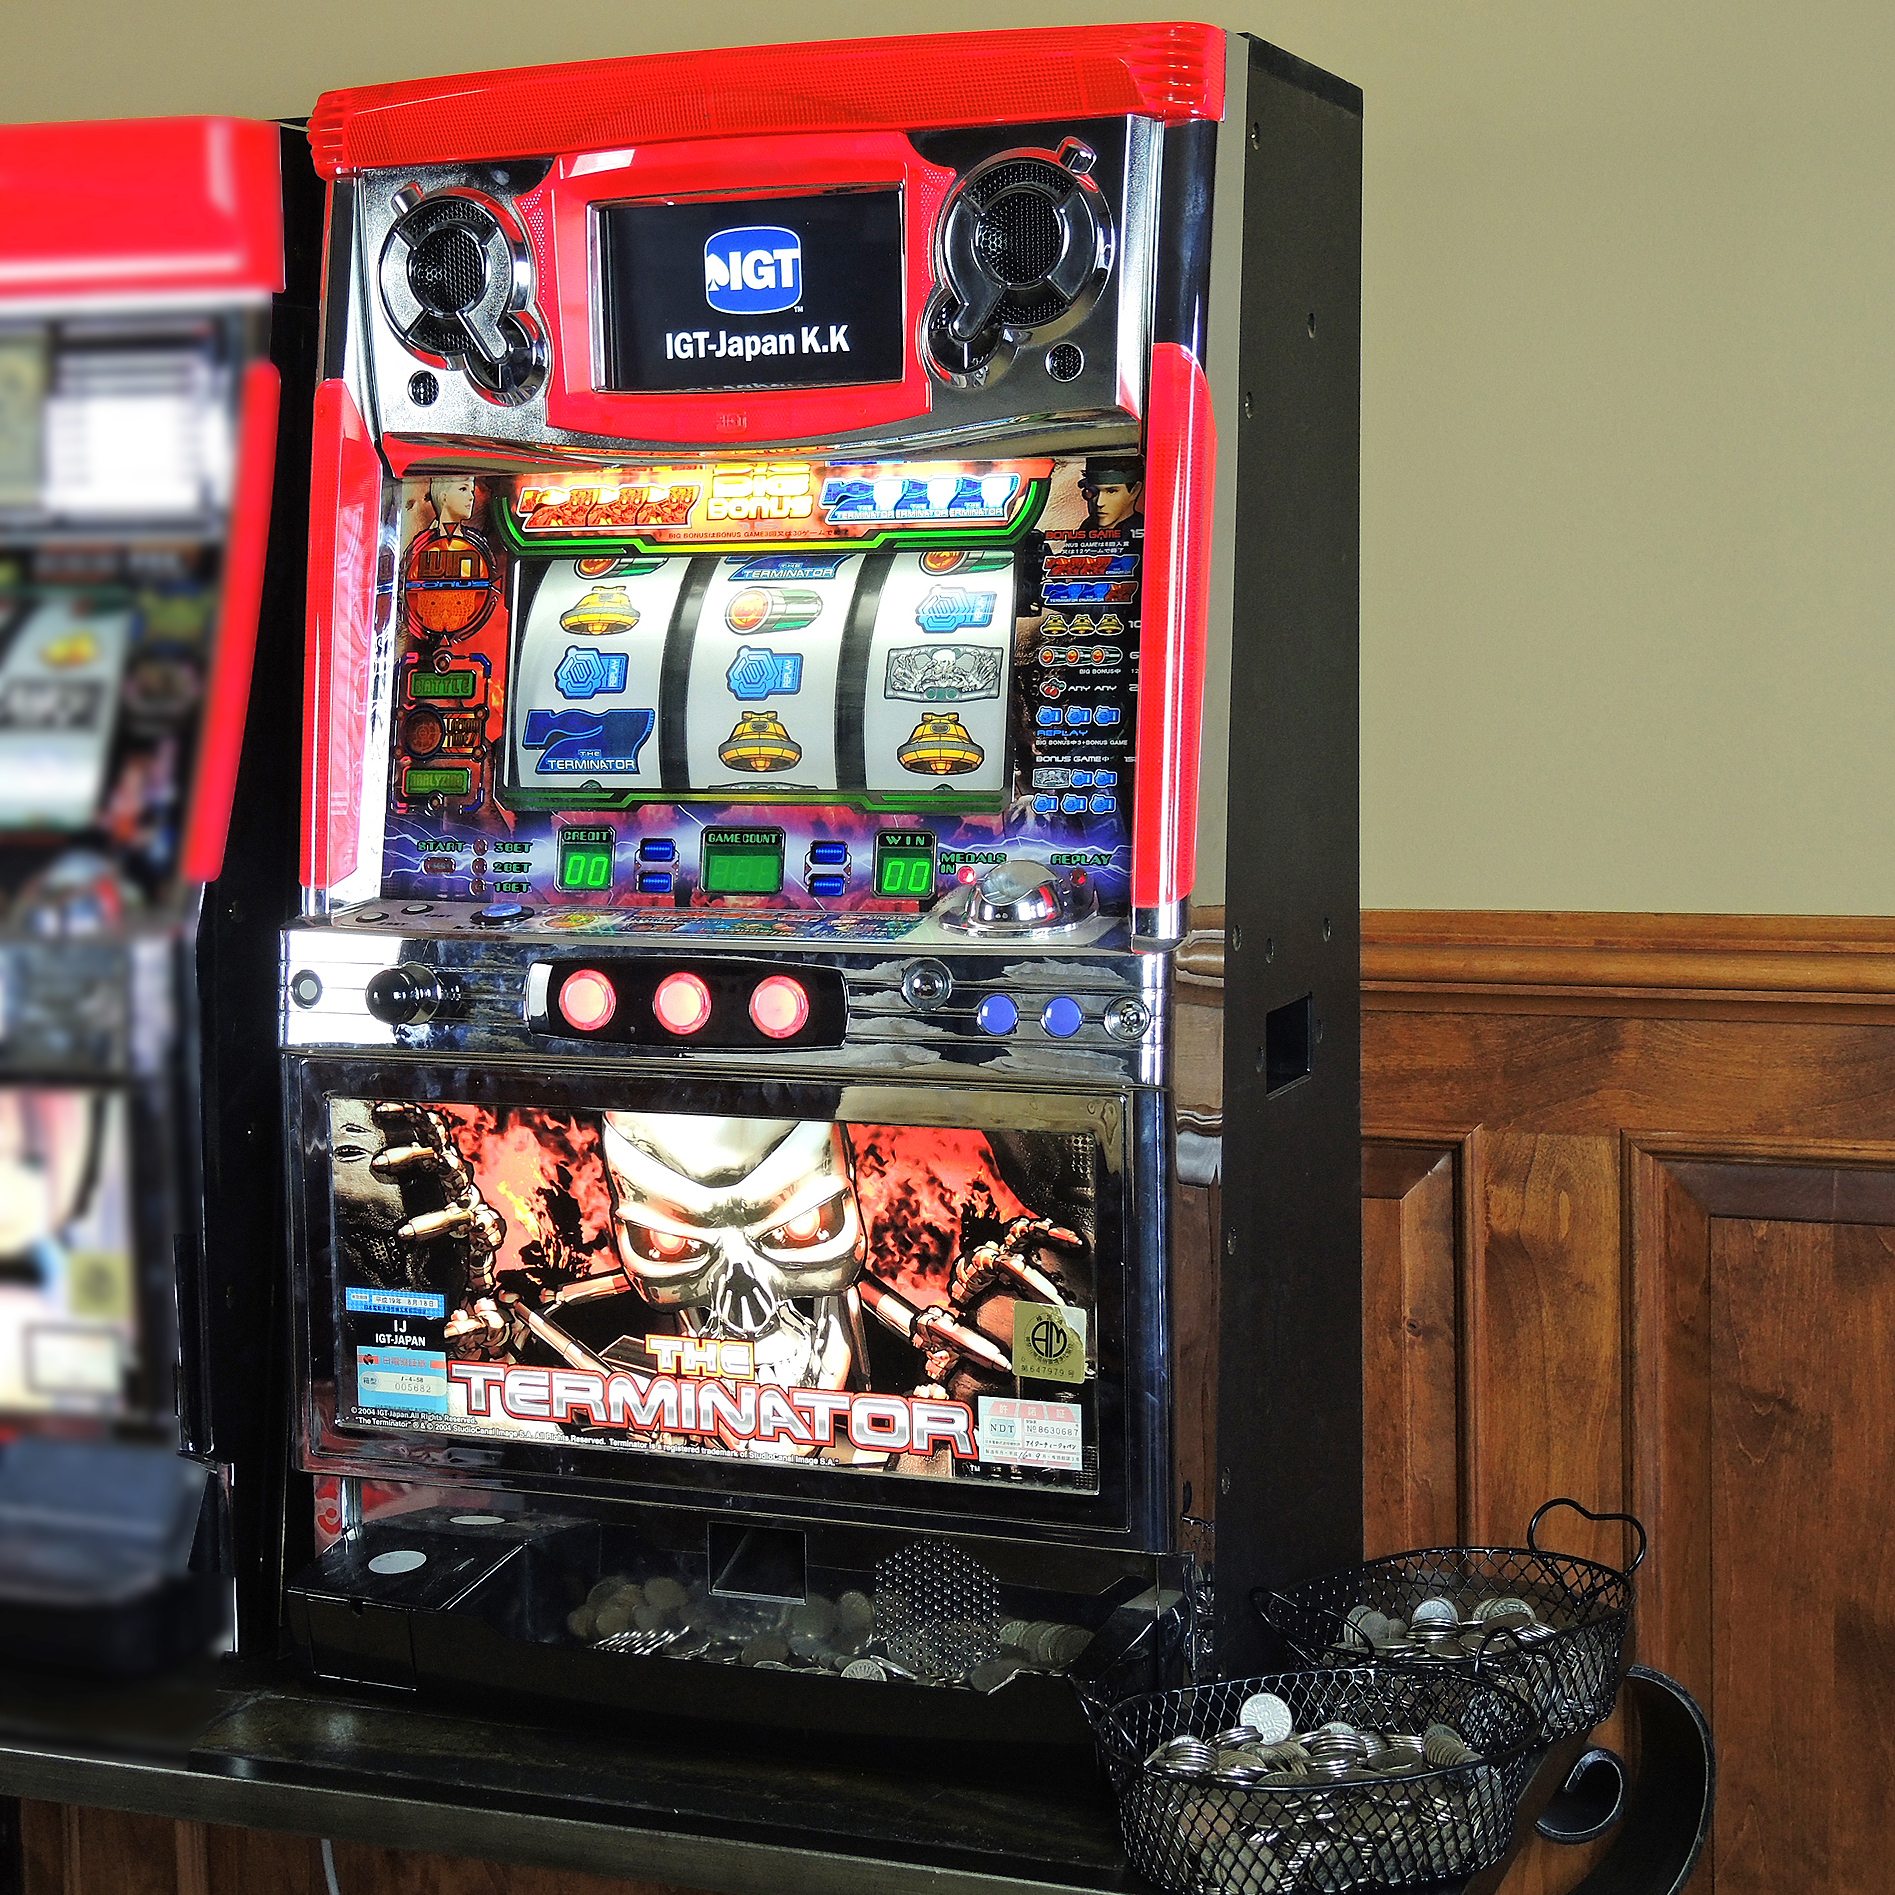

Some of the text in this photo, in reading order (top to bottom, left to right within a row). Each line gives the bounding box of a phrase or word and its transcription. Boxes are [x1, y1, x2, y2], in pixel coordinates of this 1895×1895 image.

[728, 248, 801, 291] IGT
[665, 324, 850, 361] IGT-Japan K.K
[706, 496, 813, 521] BONUS
[896, 509, 949, 518] ERMINATOR
[950, 508, 1003, 517] ERMINATOR
[1045, 530, 1086, 539] BONUS
[1089, 529, 1121, 539] GAME
[743, 568, 834, 578] TERMINATOR
[783, 659, 793, 688] REPLAY
[414, 679, 470, 694] BATTLE
[547, 759, 636, 770] TERMINATOR
[564, 831, 610, 841] CREDIT
[708, 833, 778, 843] GAME COUNT
[886, 836, 925, 846] WIN
[418, 841, 465, 851] START
[494, 842, 532, 853] 3BET
[940, 853, 1007, 864] MEDALS
[1051, 855, 1111, 865] REPLAY
[493, 862, 531, 873] 2BET
[565, 854, 609, 886] 00
[940, 864, 956, 874] IN
[883, 861, 930, 891] 00
[493, 882, 530, 893] 1BET
[393, 1320, 407, 1332] IJ
[375, 1333, 426, 1346] IGT-JAPAN
[646, 1334, 755, 1381] THE
[358, 1408, 375, 1416] 2004
[420, 1413, 443, 1422] Rights
[444, 1415, 478, 1424] Reserved.
[448, 1361, 979, 1460] TERMINATOR
[990, 1424, 1015, 1433] NDT
[435, 1424, 452, 1432] 2004
[453, 1425, 495, 1435] StudioCanal
[496, 1428, 518, 1438] Image
[535, 1431, 545, 1440] All
[546, 1433, 569, 1442] Rights
[570, 1434, 606, 1445] Reserved.
[608, 1438, 647, 1449] Terminator
[663, 1444, 700, 1455] registered
[701, 1446, 738, 1458] trademark
[740, 1450, 748, 1458] of
[749, 1451, 794, 1463] StudioCanal
[795, 1456, 818, 1466] Image
